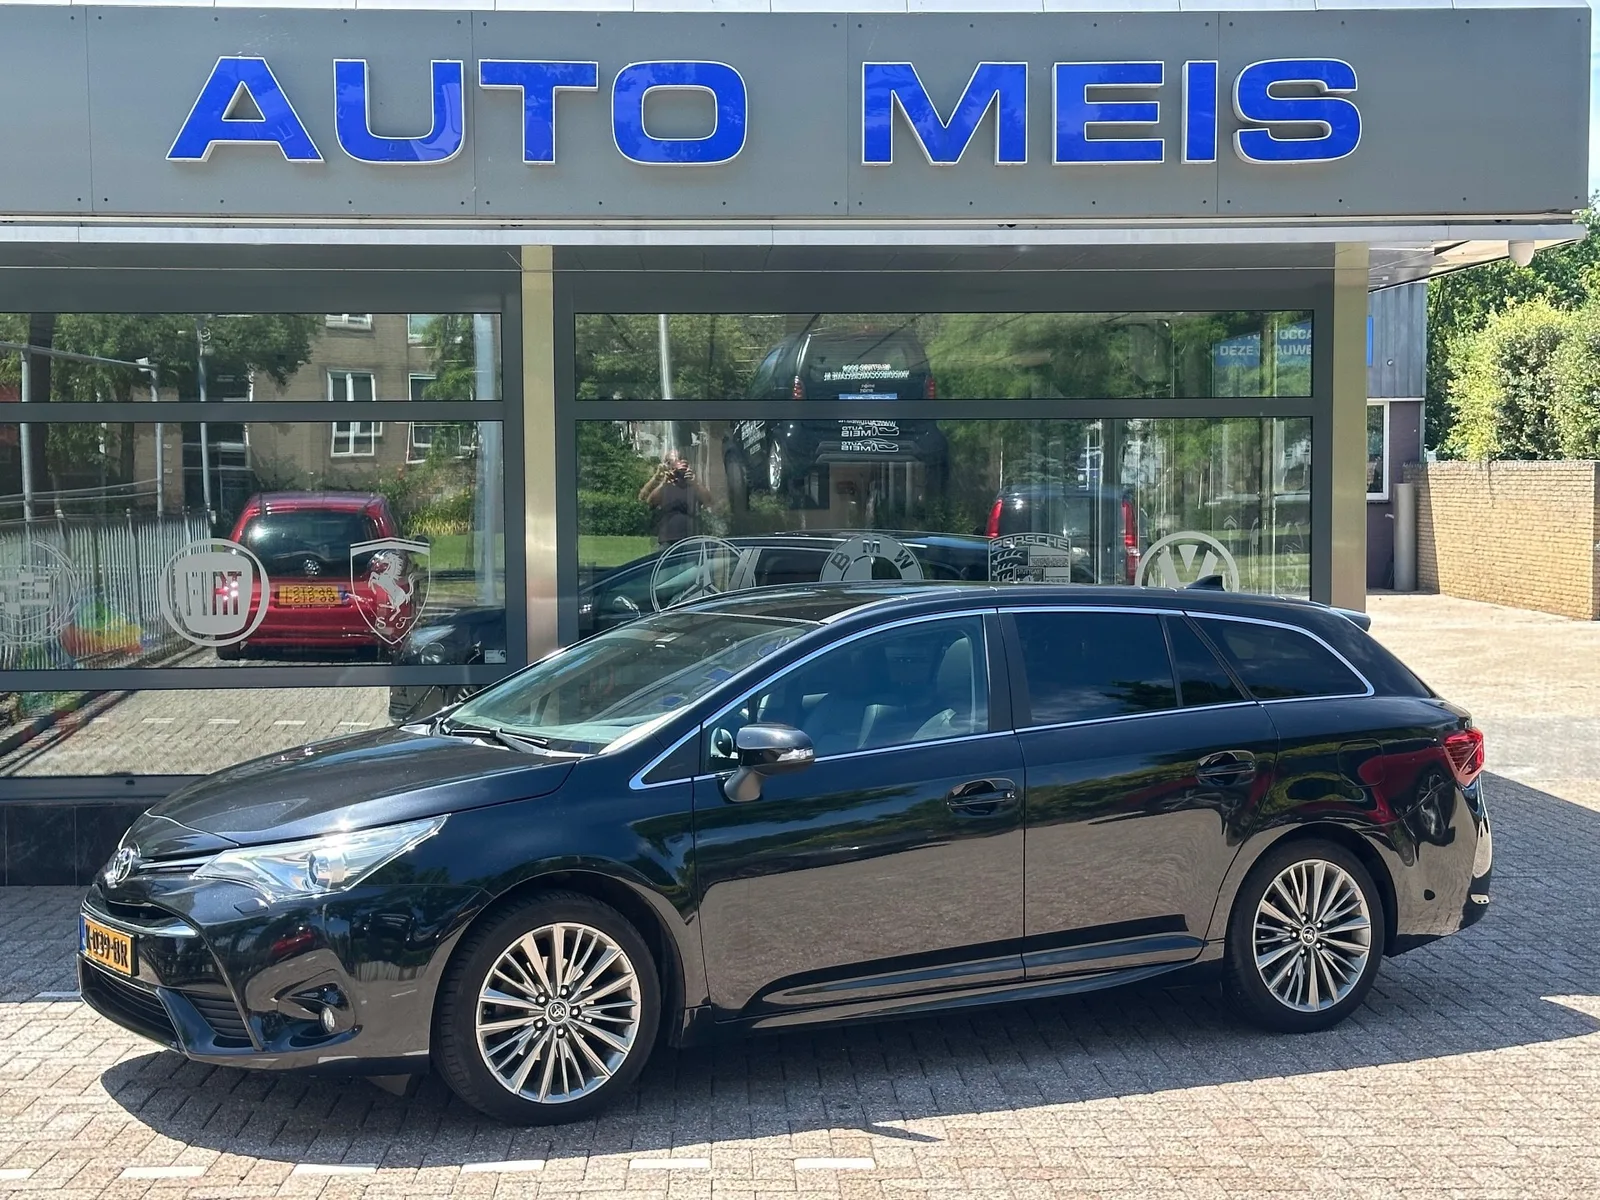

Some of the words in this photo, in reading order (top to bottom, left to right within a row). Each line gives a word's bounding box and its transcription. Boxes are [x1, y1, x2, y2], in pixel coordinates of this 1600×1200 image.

[165, 55, 748, 166] AUTO
[860, 57, 1362, 165] MEIS
[1219, 345, 1254, 356] DEZE
[831, 539, 915, 571] BMW
[991, 535, 1068, 551] PORSCHE
[186, 571, 242, 616] FIAT
